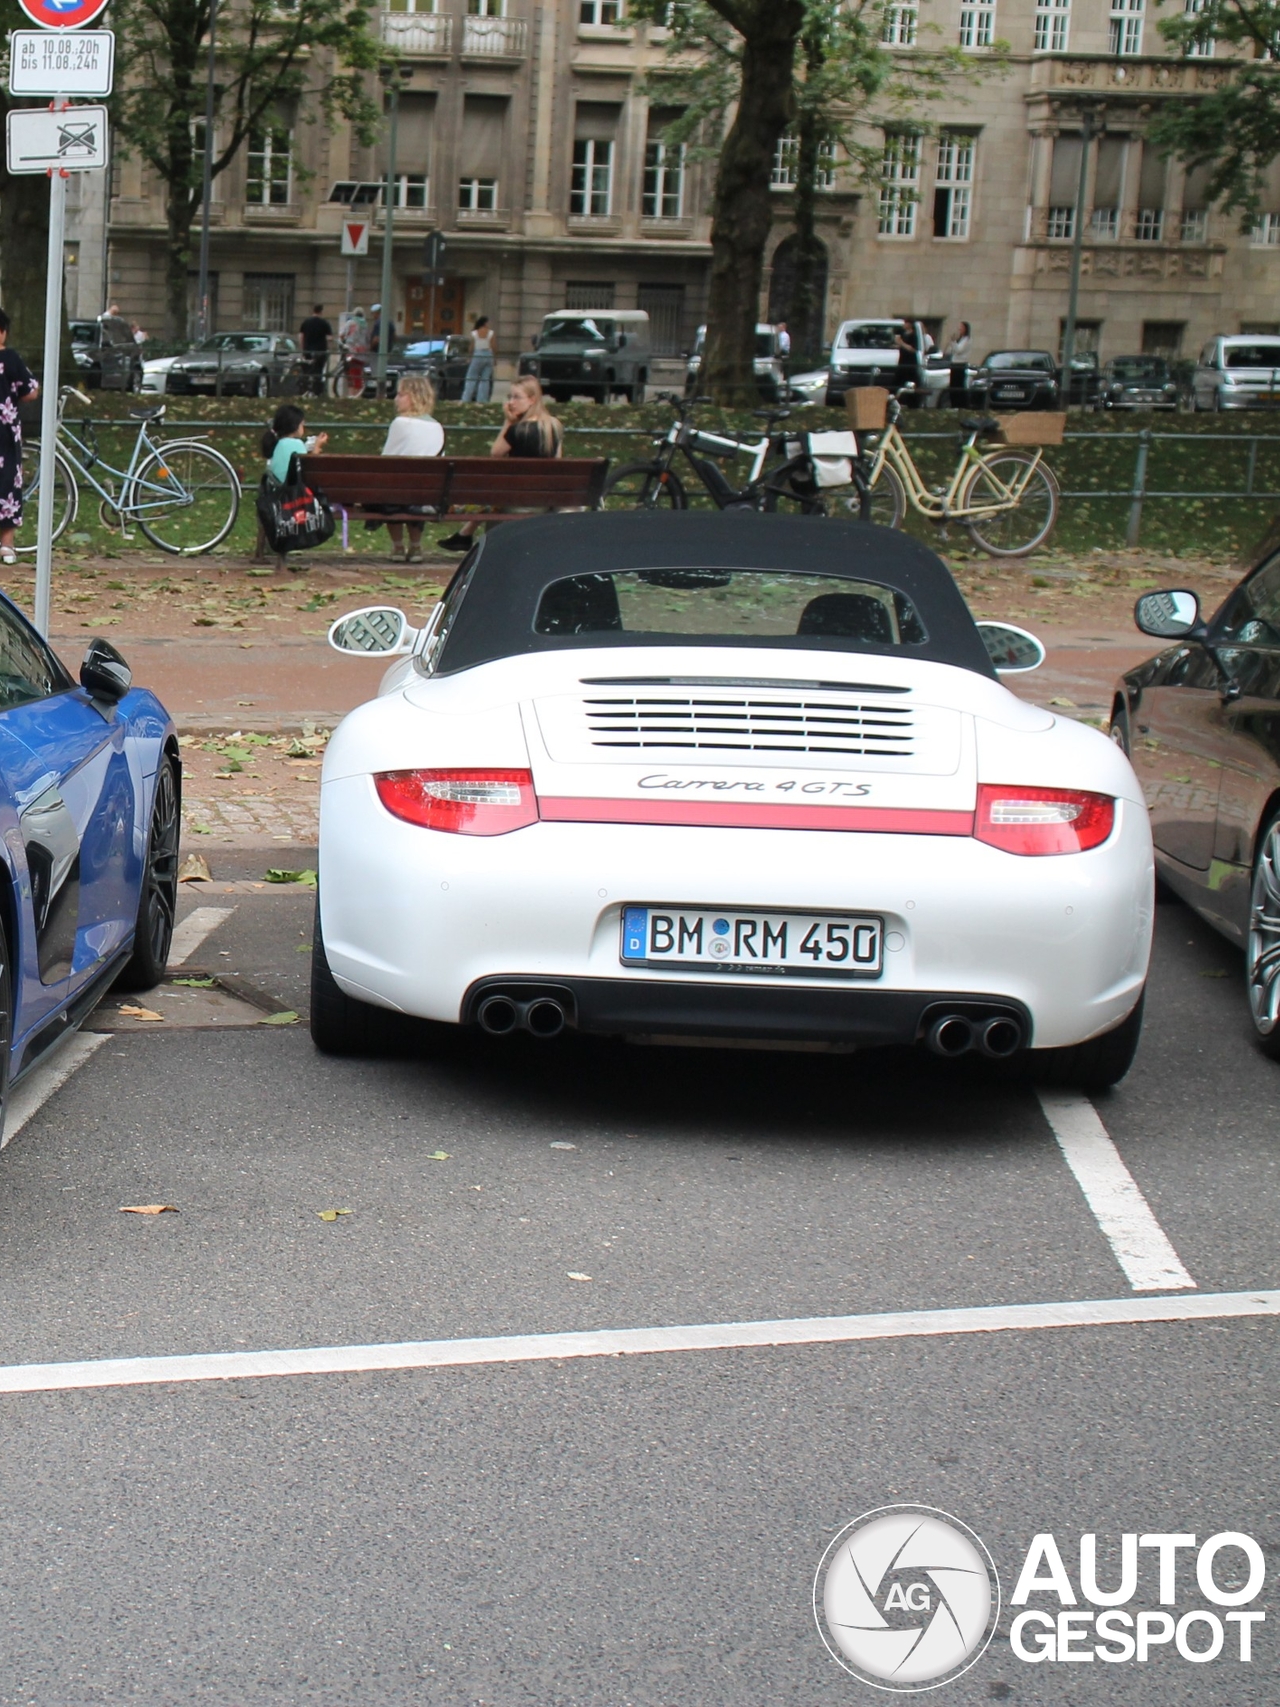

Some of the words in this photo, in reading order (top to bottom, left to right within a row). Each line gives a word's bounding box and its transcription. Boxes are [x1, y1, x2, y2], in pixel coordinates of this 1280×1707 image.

[22, 39, 35, 54] ab
[21, 54, 38, 70] bis
[637, 774, 765, 792] Carrera
[630, 937, 641, 950] D
[650, 915, 704, 955] BM
[733, 918, 788, 959] RM
[799, 922, 876, 963] 450
